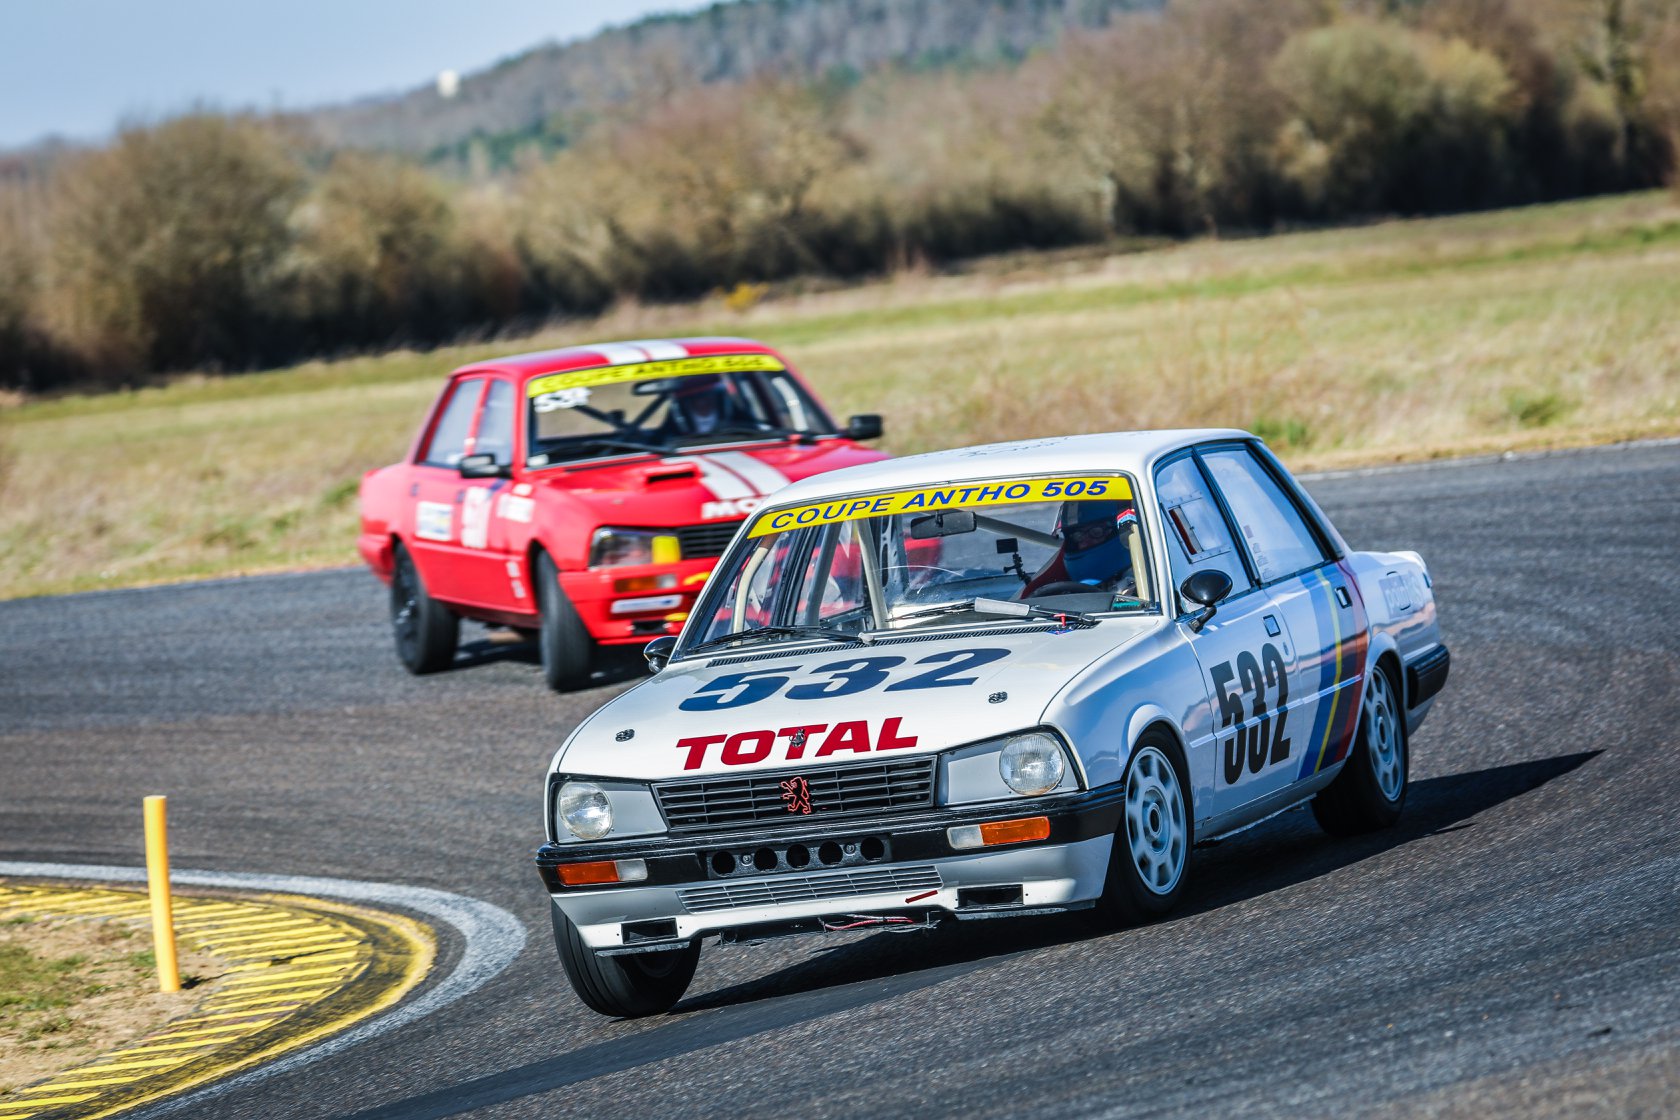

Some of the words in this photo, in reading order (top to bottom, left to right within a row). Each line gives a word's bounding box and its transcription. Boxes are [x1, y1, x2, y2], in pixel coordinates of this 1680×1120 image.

[771, 496, 896, 529] COUPE
[902, 483, 1032, 509] ANTHO
[1042, 480, 1110, 498] 505
[678, 648, 1012, 712] 532
[1210, 643, 1291, 785] 532
[676, 717, 919, 770] TOTAL
